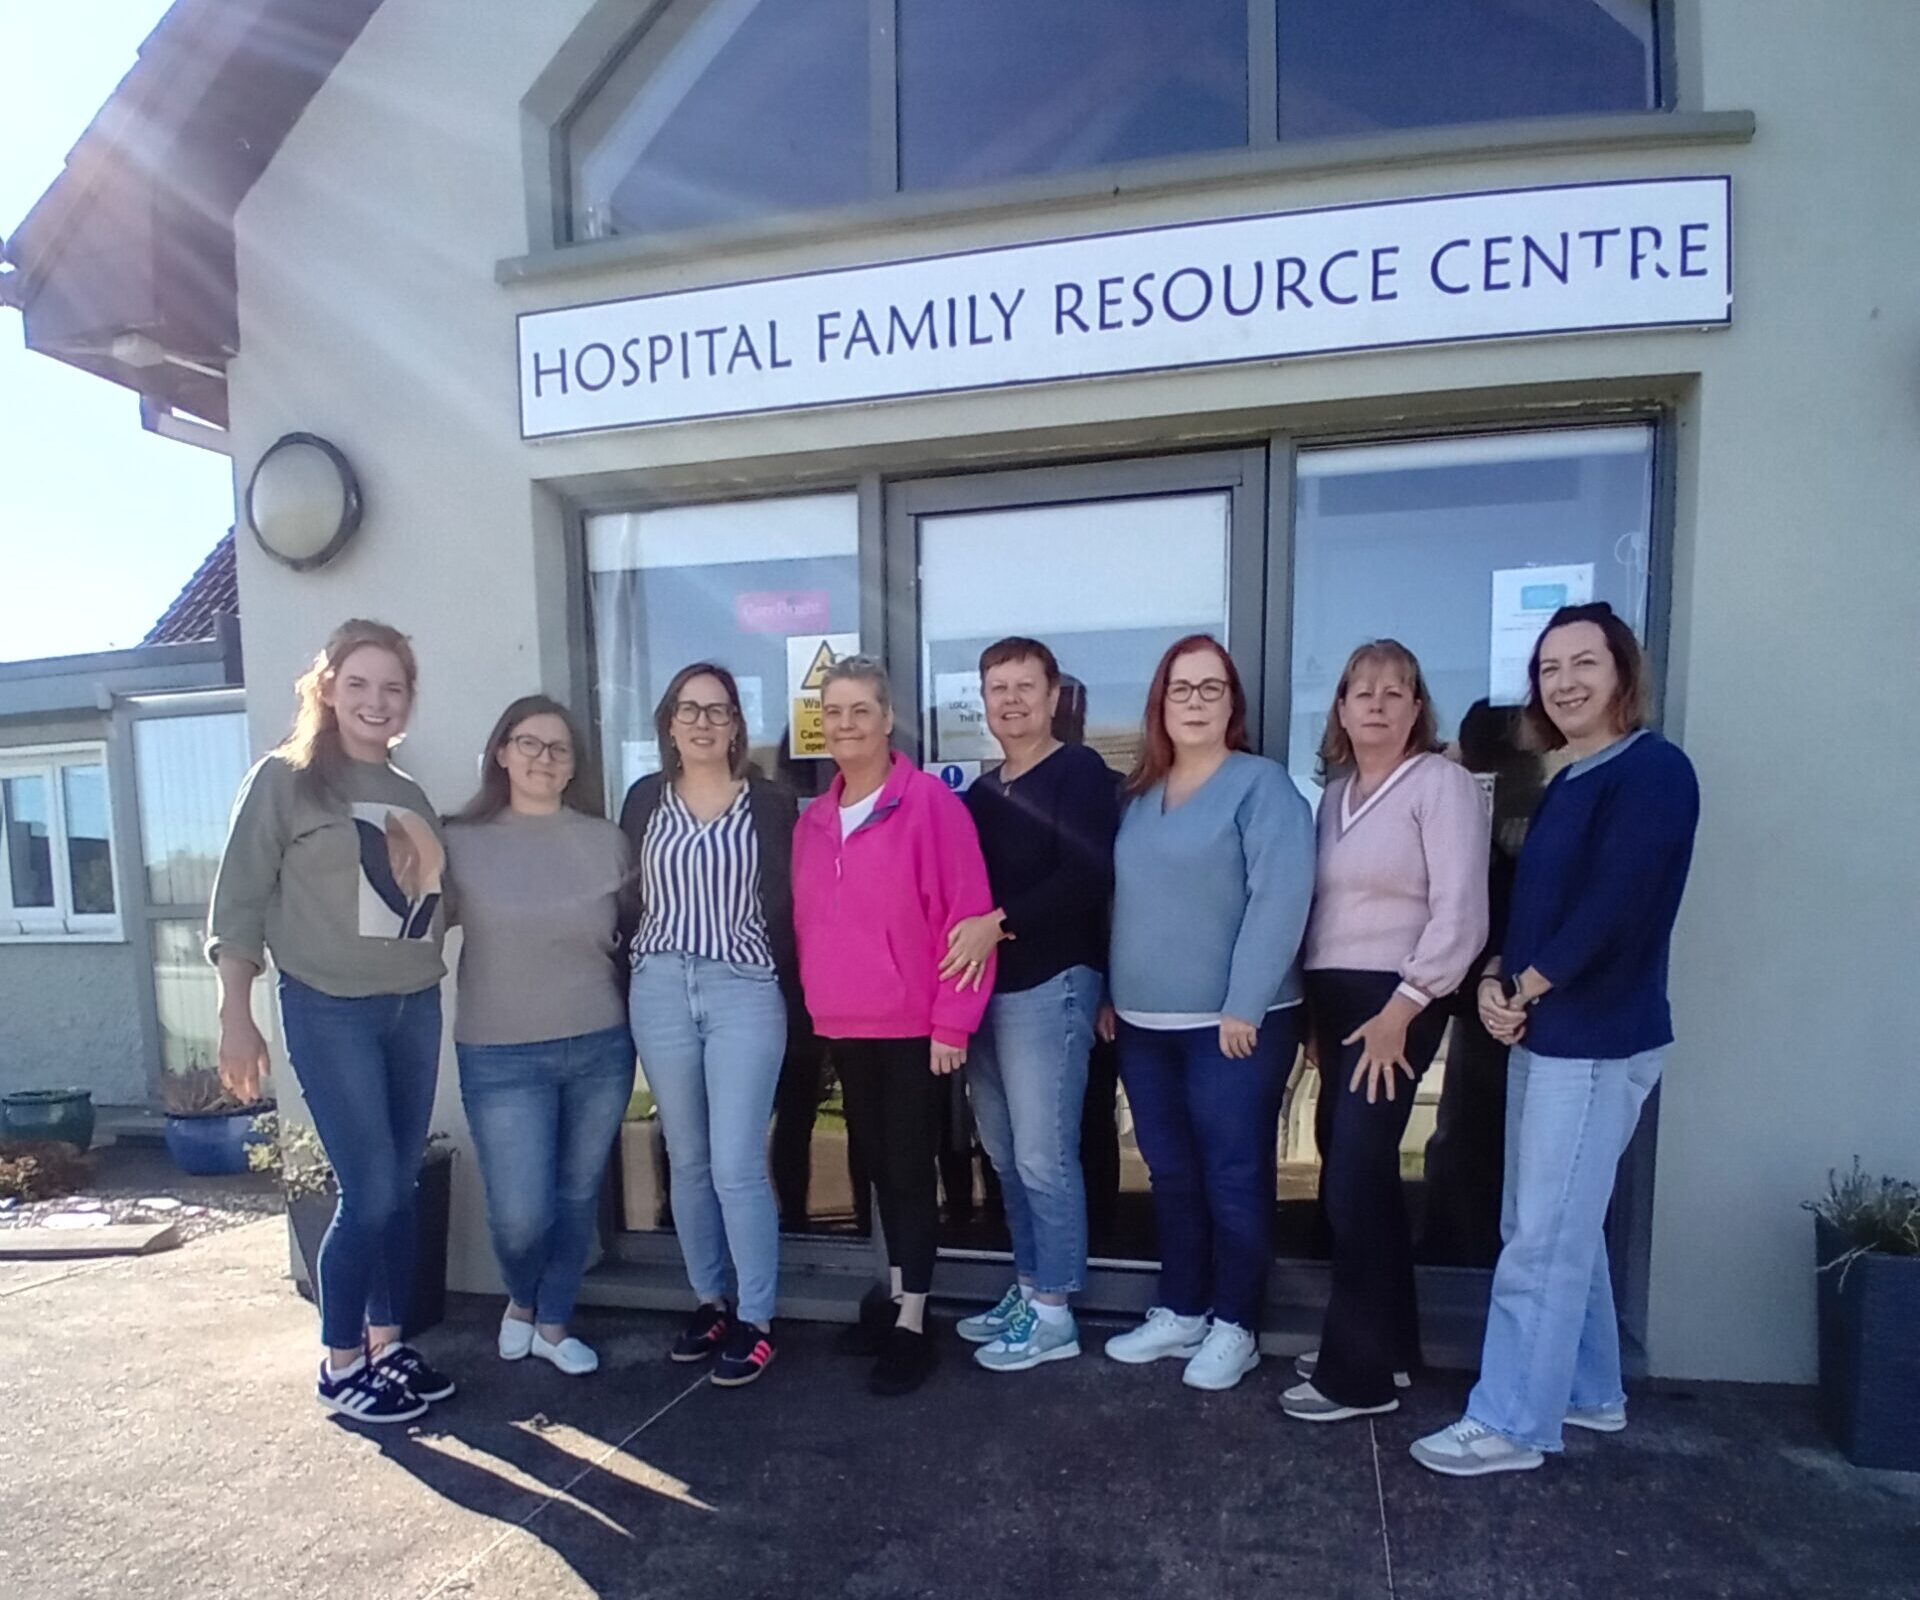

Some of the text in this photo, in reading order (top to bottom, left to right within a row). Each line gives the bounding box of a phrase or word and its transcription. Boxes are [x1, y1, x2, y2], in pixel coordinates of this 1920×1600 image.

[533, 222, 1710, 398] HOSPITAL FAMILY RESOURCE CENTRE
